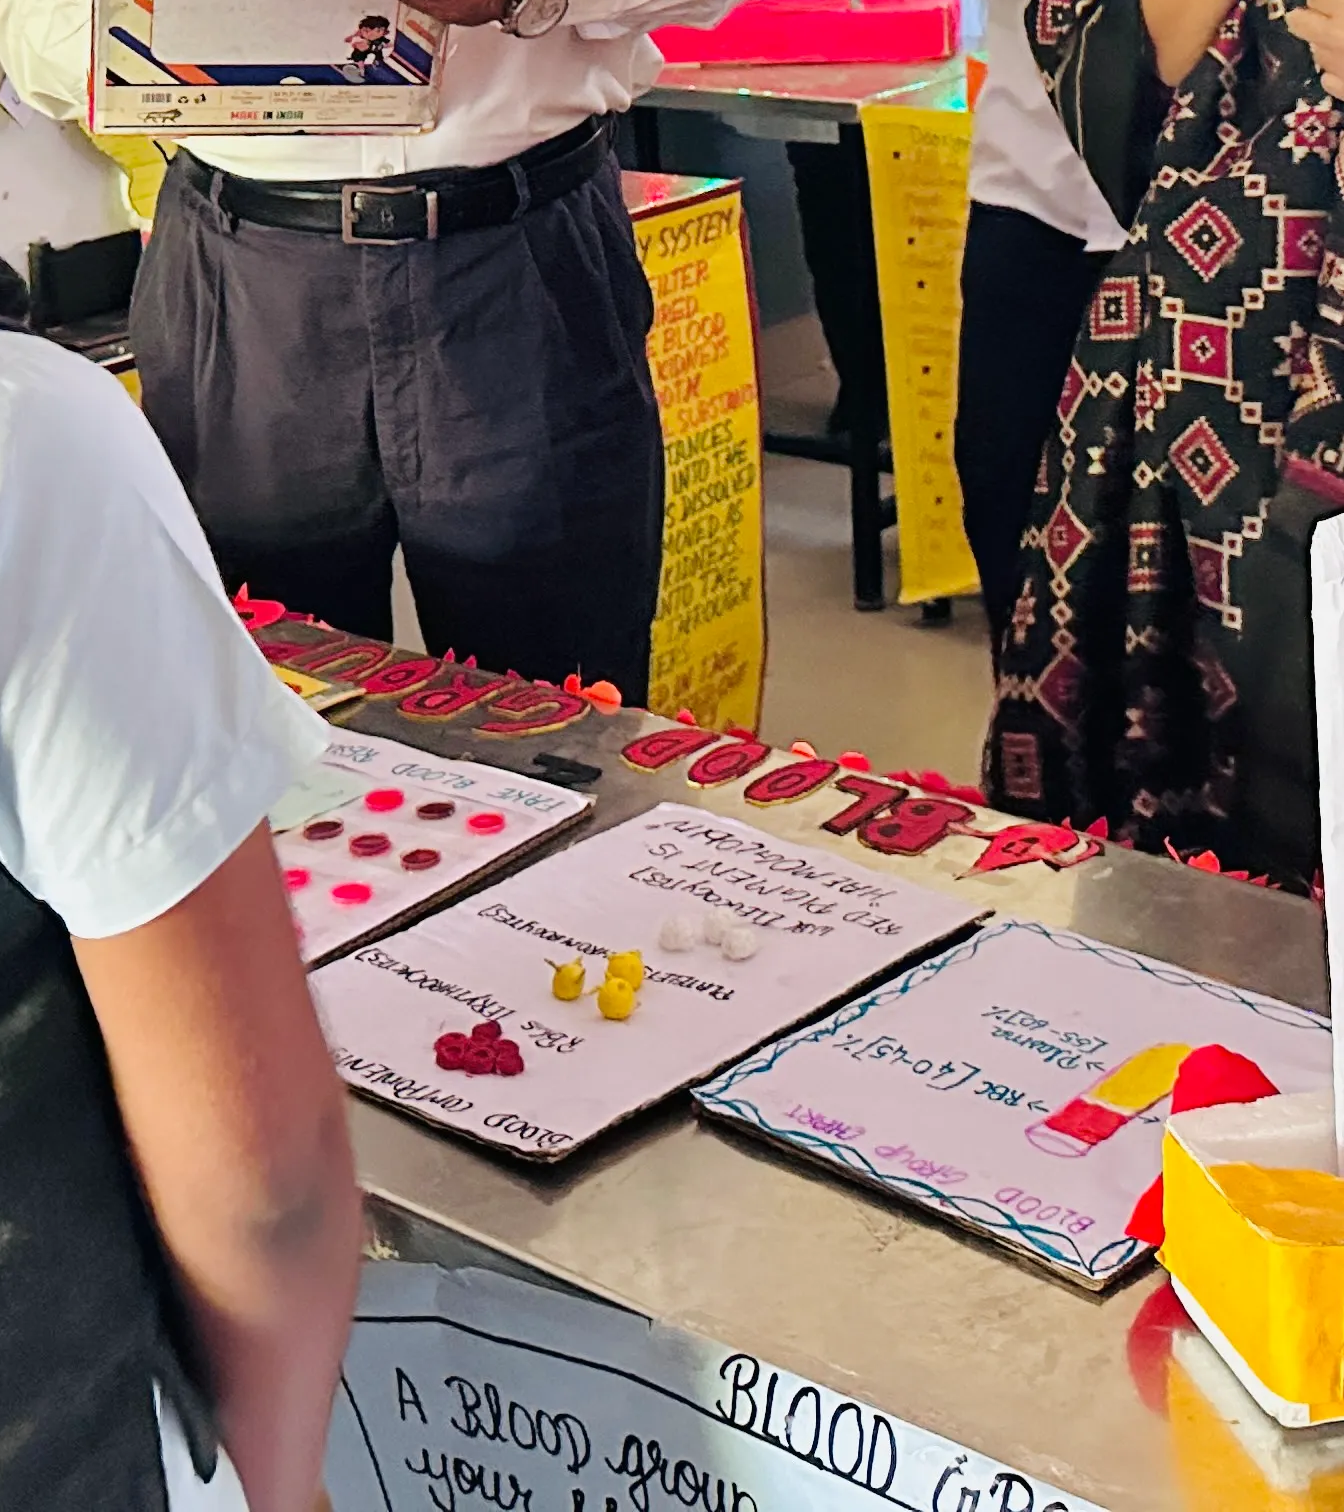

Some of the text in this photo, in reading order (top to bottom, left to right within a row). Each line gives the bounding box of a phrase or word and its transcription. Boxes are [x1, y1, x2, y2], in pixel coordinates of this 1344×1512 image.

[483, 1113, 573, 1149] BLOOD
[874, 1143, 969, 1185] GROUP
[994, 1187, 1096, 1235] BLOOD
[394, 1367, 428, 1424] A
[717, 1354, 899, 1496] BLOOD
